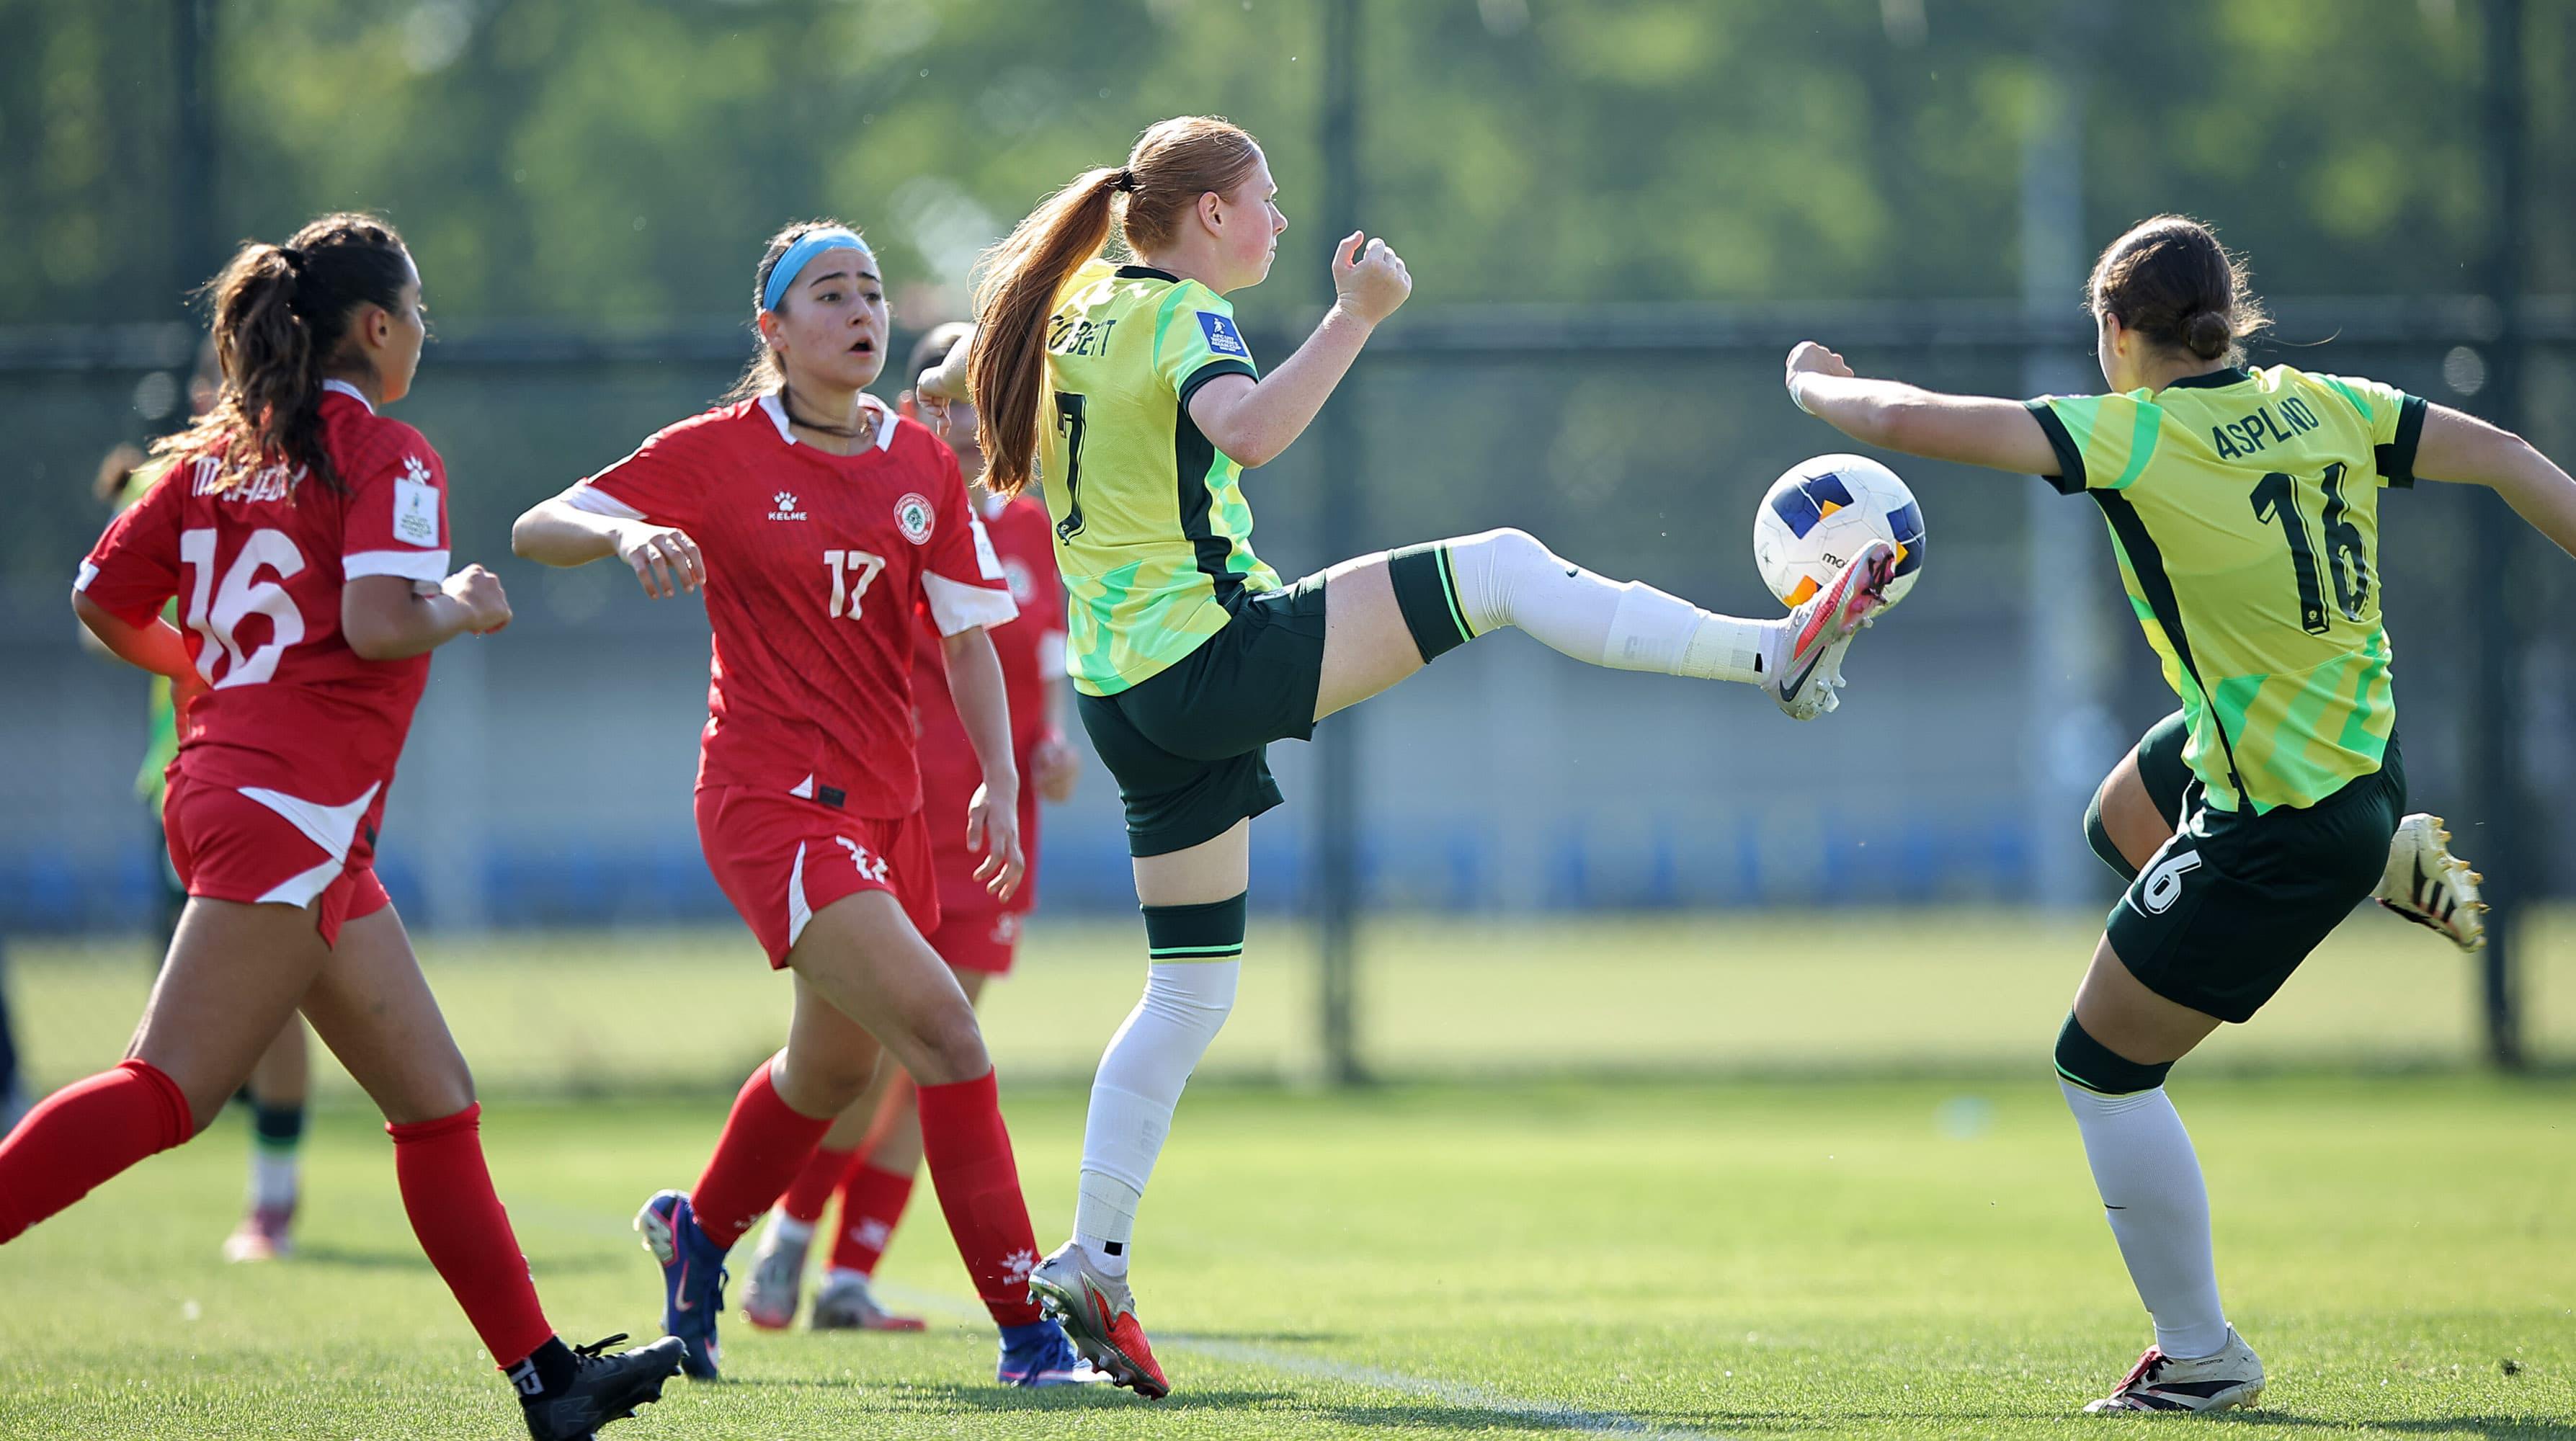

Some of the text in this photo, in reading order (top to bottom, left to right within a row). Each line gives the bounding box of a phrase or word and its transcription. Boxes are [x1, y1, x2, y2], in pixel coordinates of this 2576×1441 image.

[767, 512, 808, 521] KELME
[1054, 391, 1087, 545] 7
[181, 527, 306, 690] 16
[824, 550, 886, 620] 17
[2250, 462, 2371, 635] 16
